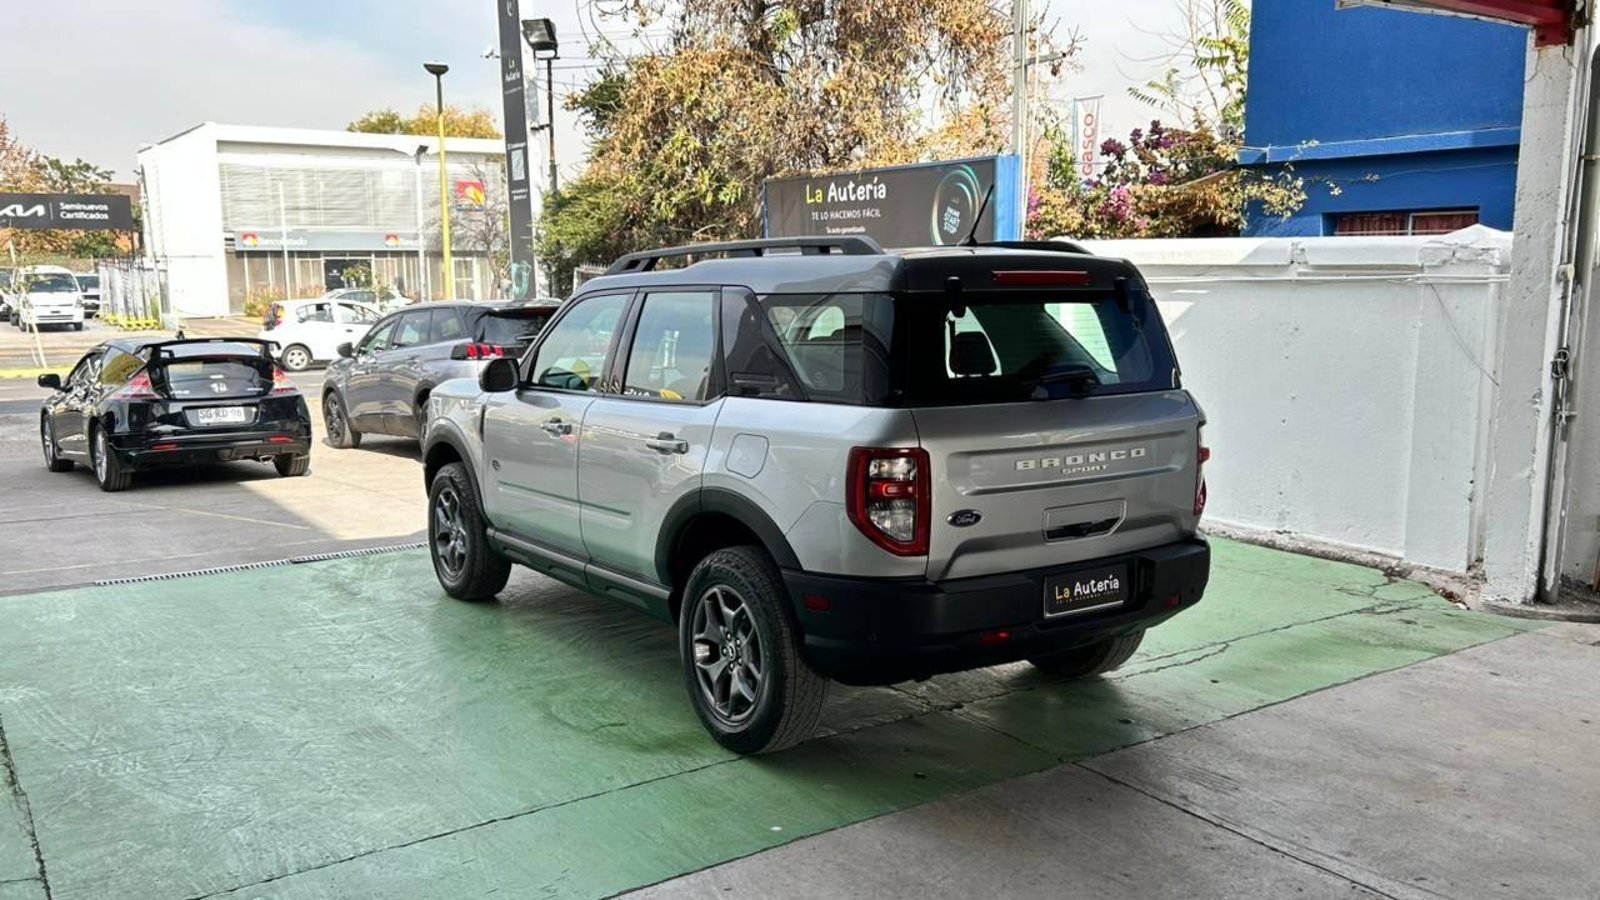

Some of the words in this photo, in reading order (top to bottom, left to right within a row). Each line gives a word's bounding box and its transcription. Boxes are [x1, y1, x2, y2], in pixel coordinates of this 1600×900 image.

[806, 184, 823, 204] La
[827, 176, 887, 202] Autería
[60, 202, 108, 211] Seminuevos
[60, 211, 109, 220] Certificados
[830, 209, 861, 220] HACEMOS
[1016, 448, 1146, 470] BRONCO
[1061, 464, 1108, 475] SPORT
[1055, 585, 1070, 600] La
[1074, 574, 1120, 597] Autería
